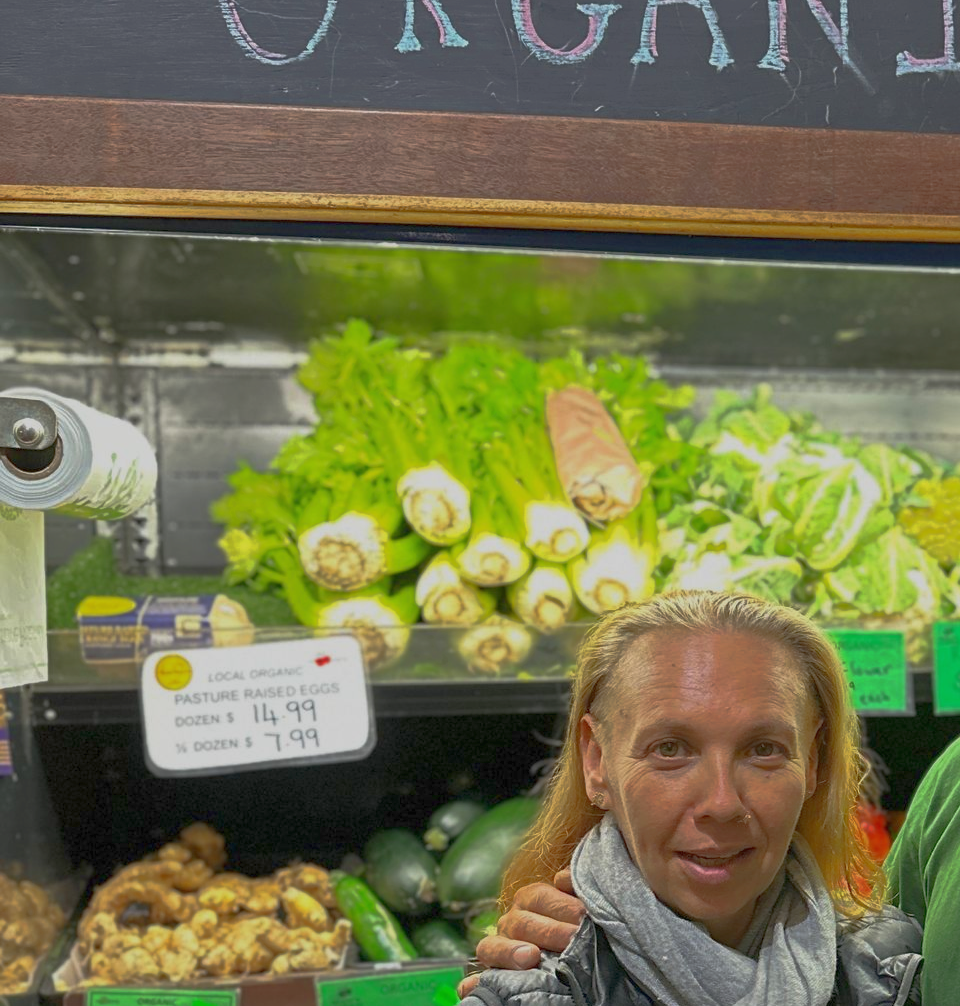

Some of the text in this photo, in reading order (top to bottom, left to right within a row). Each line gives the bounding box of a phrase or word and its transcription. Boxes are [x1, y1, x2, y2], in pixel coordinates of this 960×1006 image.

[208, 667, 303, 683] LOCAL ORGANIC
[174, 682, 341, 706] PASTURE RAISED EGGS
[175, 713, 220, 727] DOZEN
[252, 699, 318, 726] 14.99
[193, 738, 239, 752] DOZEN
[264, 728, 320, 751] 7.99
